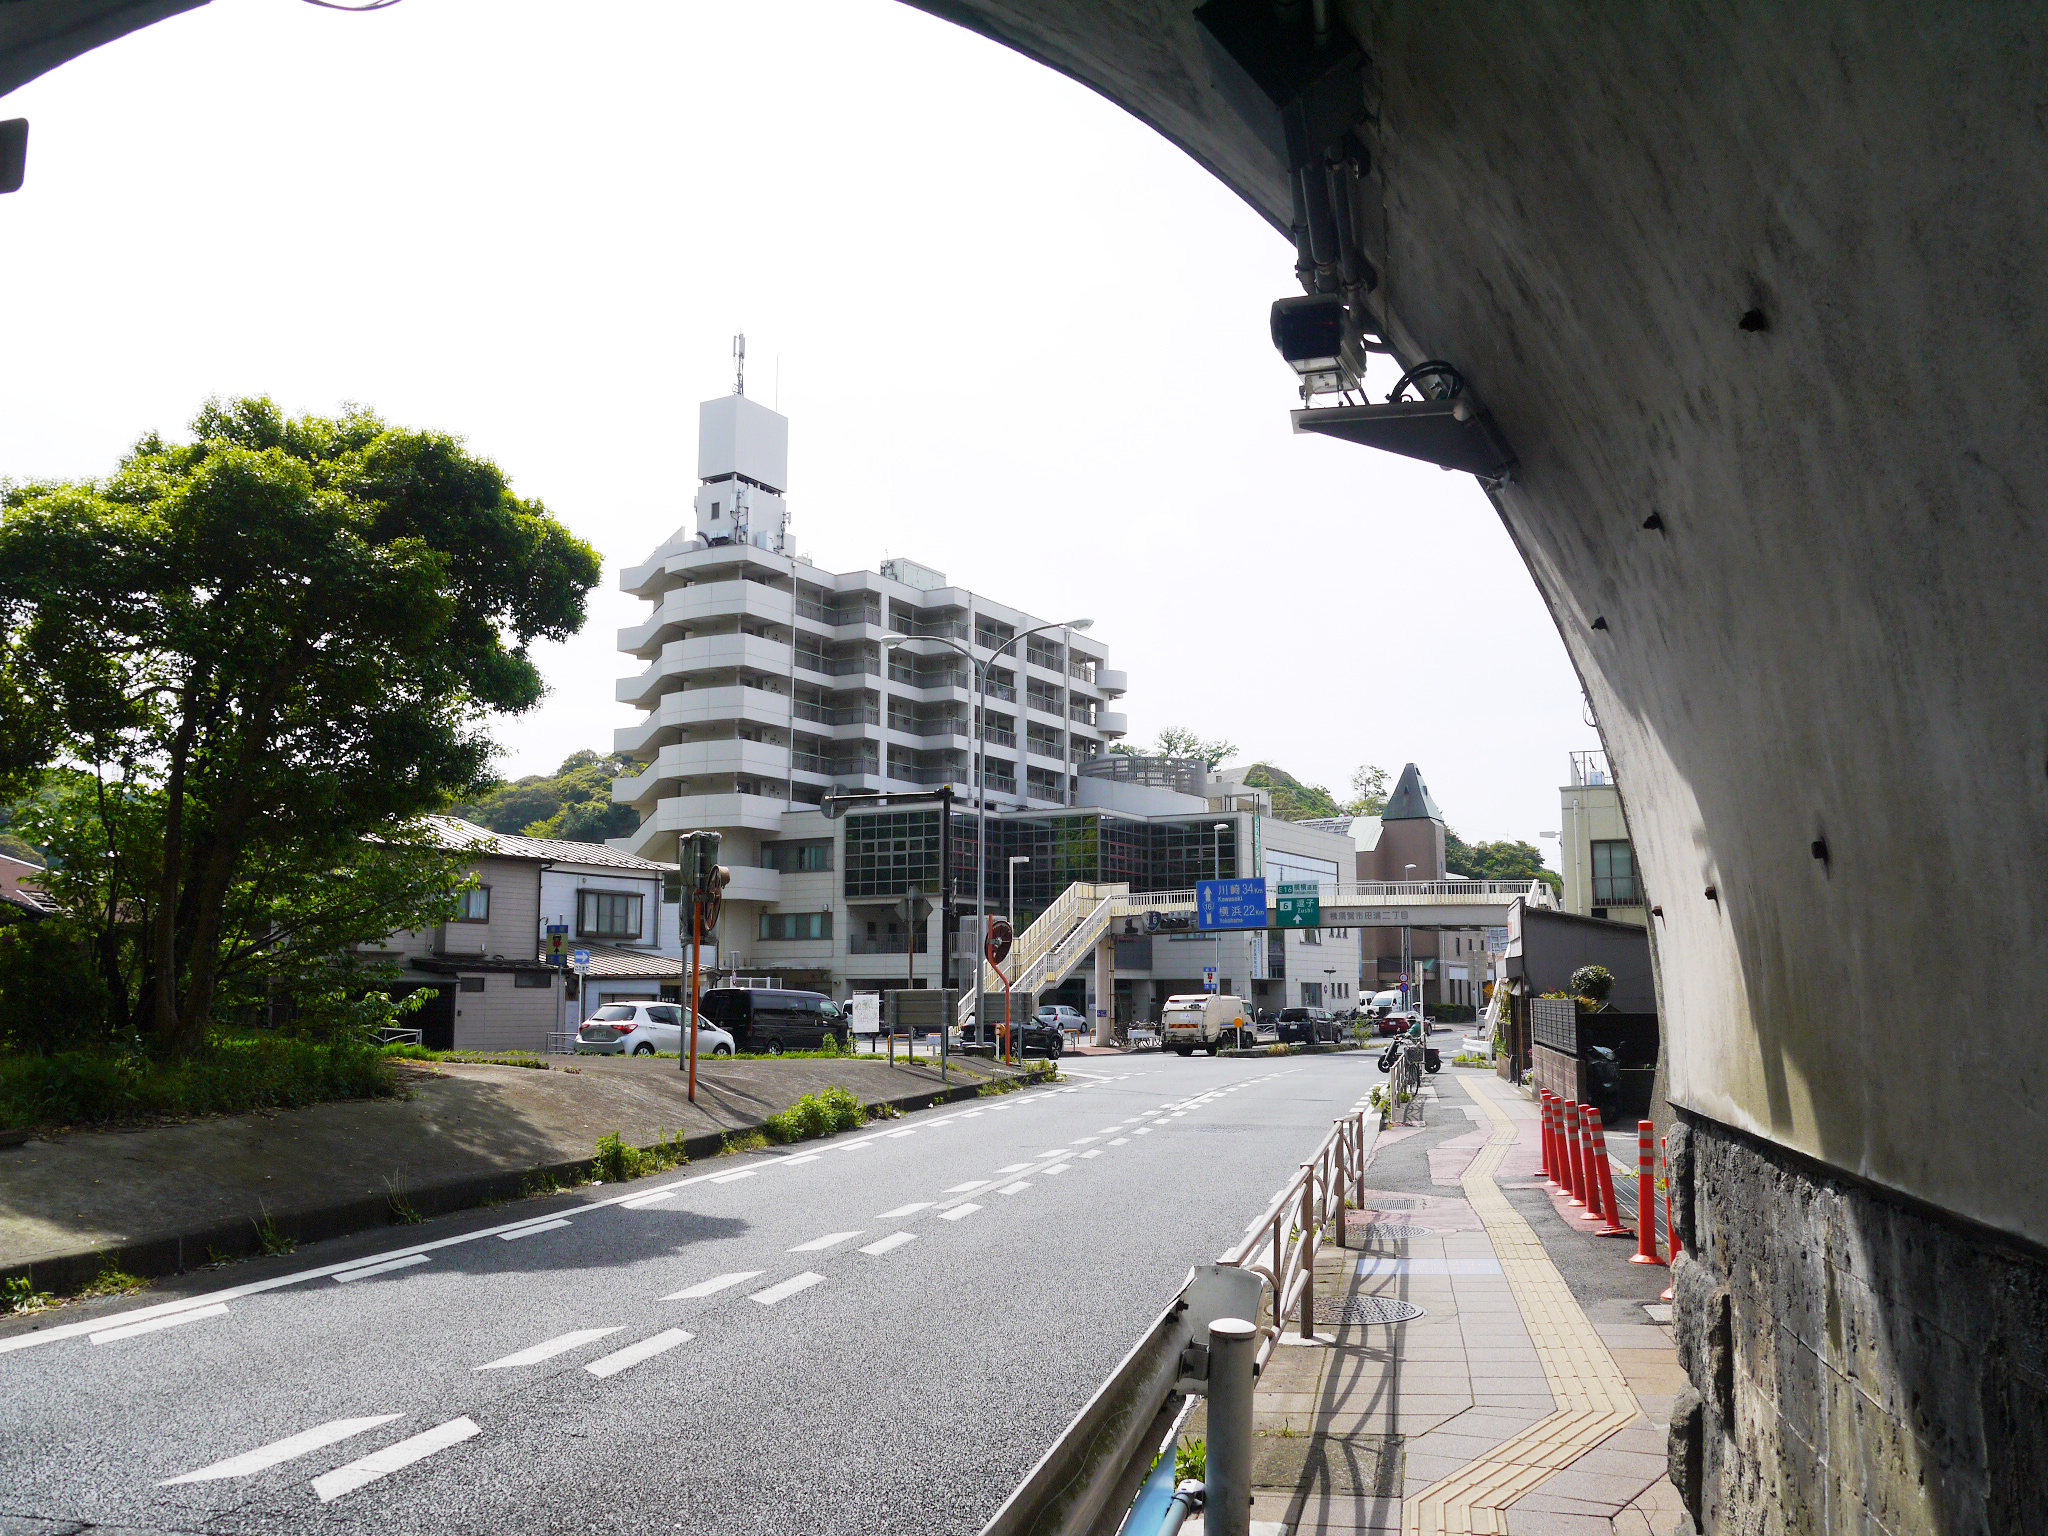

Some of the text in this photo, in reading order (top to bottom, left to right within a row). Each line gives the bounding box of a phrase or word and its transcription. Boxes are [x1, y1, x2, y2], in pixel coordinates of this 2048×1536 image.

[1218, 884, 1240, 895] 川崎
[1205, 903, 1212, 911] 16
[1283, 902, 1289, 910] 6
[1296, 898, 1315, 908] 逗子
[1219, 906, 1242, 917] 横浜
[1329, 910, 1409, 921] 横須賀市田浦二丁目
